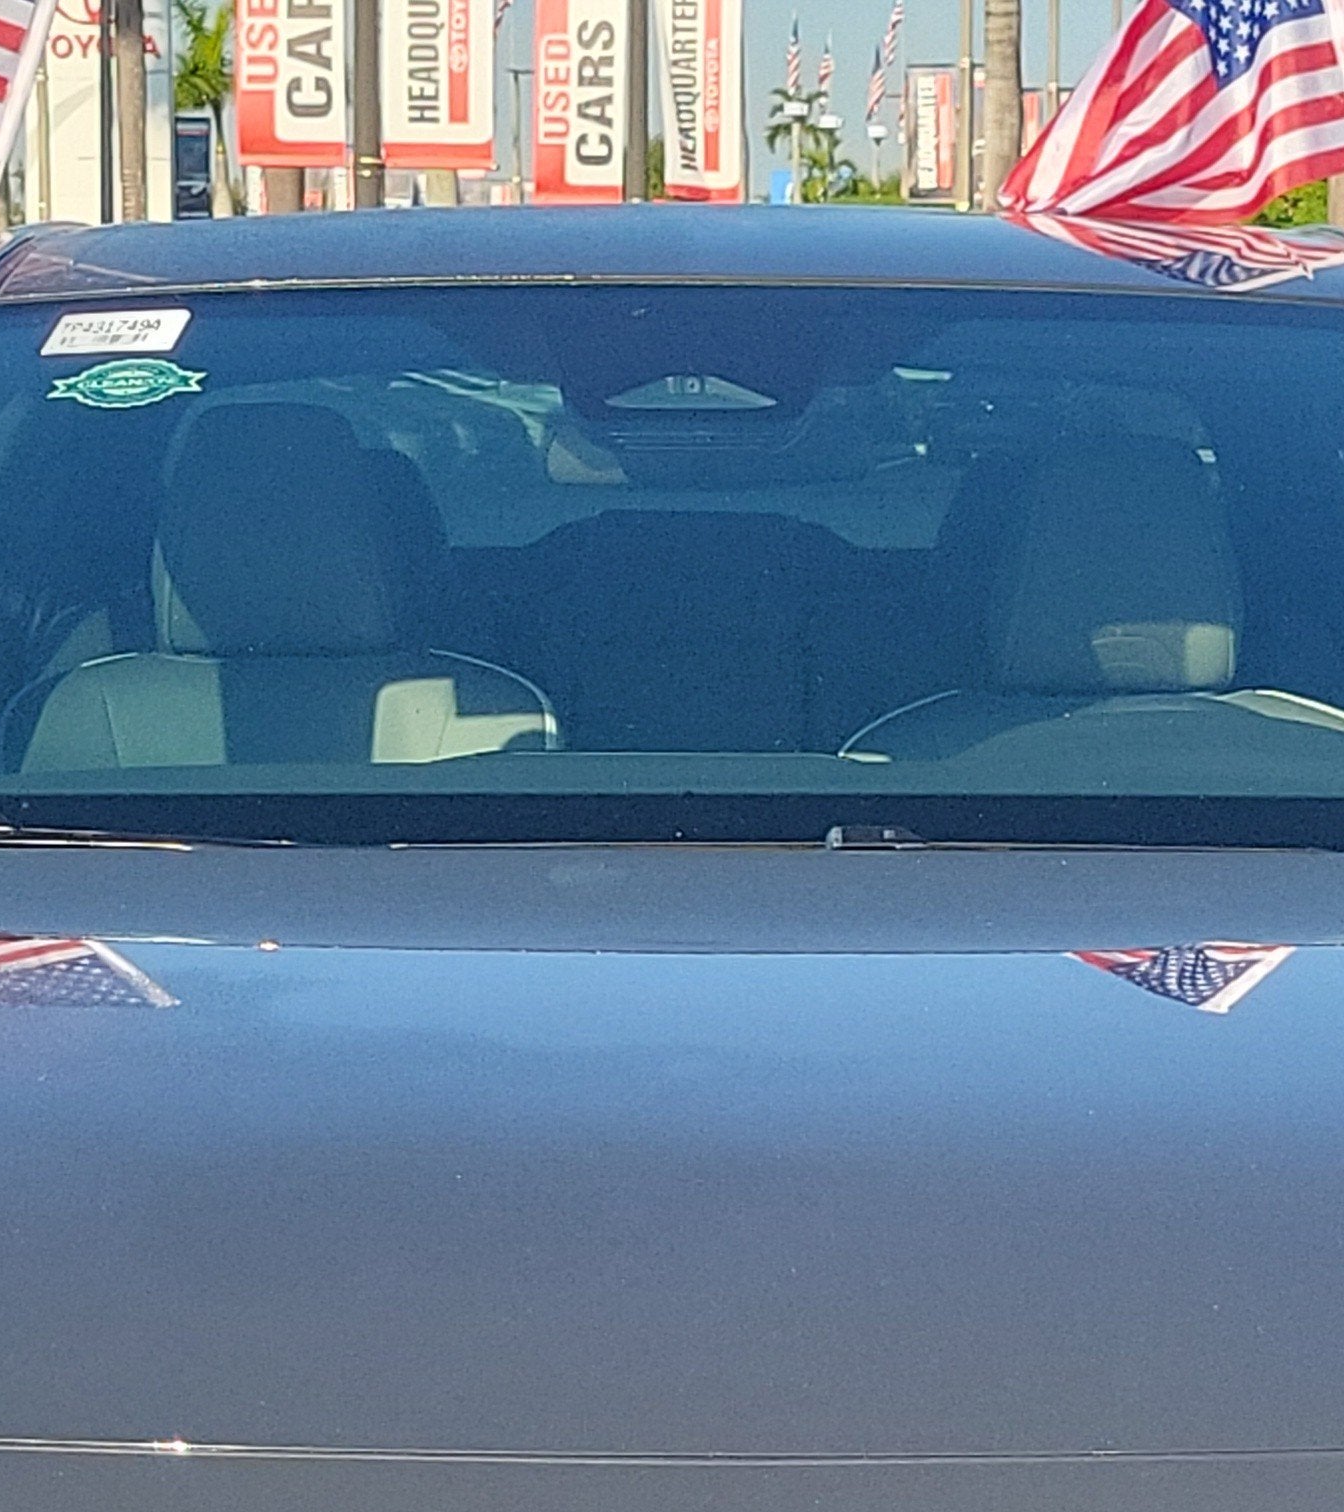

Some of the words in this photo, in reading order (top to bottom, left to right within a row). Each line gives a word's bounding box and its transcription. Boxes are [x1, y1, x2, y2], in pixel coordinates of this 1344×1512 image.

[544, 39, 571, 139] USED
[575, 19, 615, 166] CARS
[704, 37, 720, 109] TOYOTA
